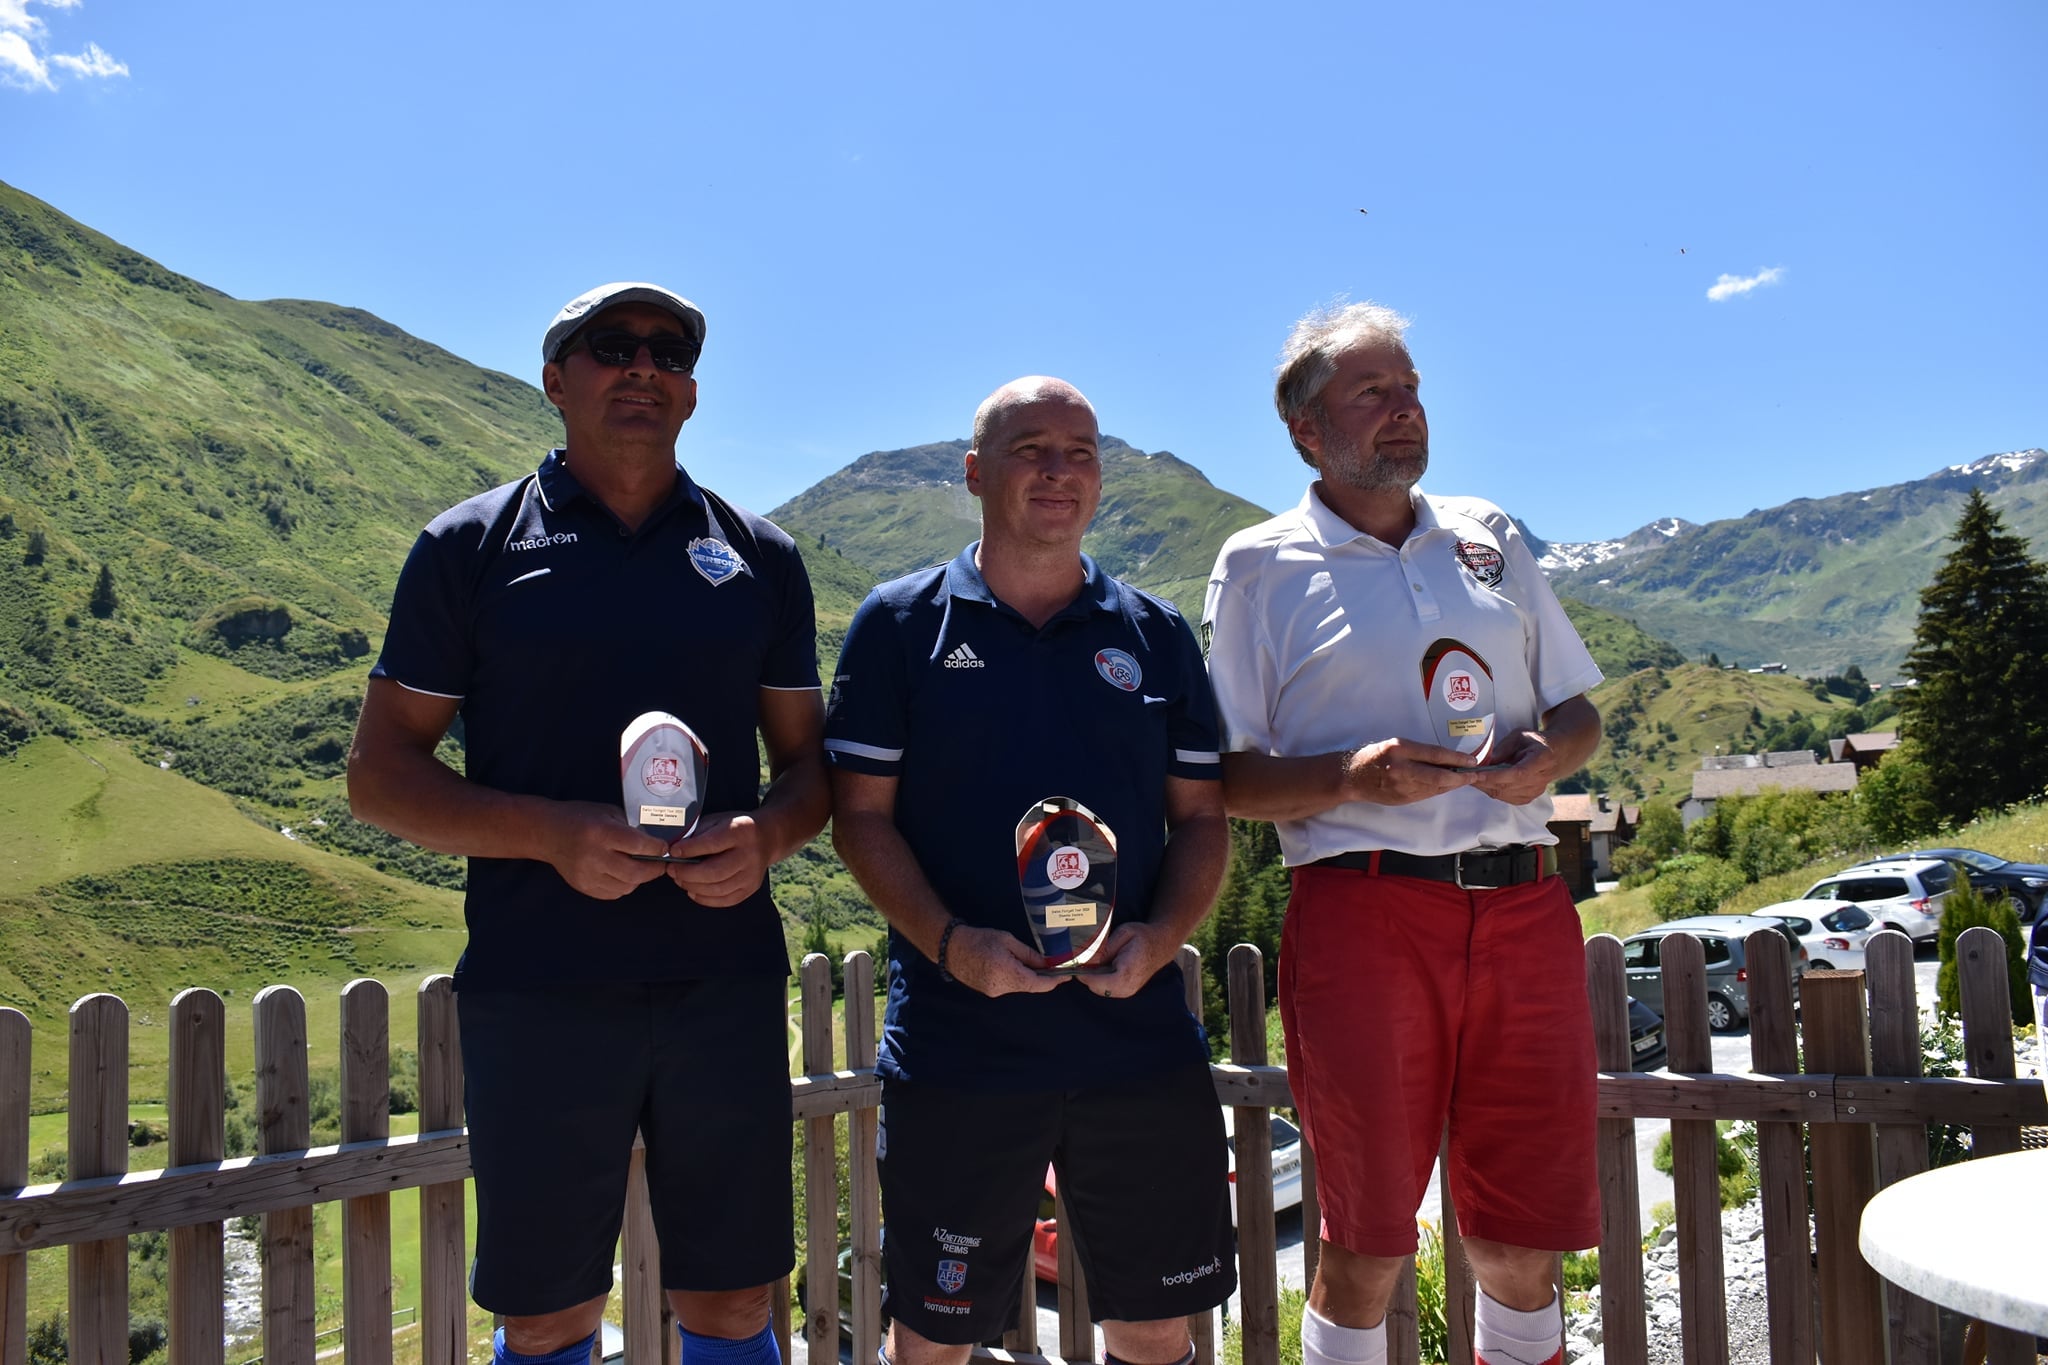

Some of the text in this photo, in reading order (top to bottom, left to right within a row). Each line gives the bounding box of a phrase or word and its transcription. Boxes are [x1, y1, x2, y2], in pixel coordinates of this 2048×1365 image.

[510, 532, 578, 551] macron
[943, 658, 985, 668] adidas
[943, 1244, 968, 1254] REIMS
[940, 1272, 963, 1281] AFFG
[1162, 1263, 1215, 1286] footgolfer
[924, 1302, 955, 1313] FOOTGOLF
